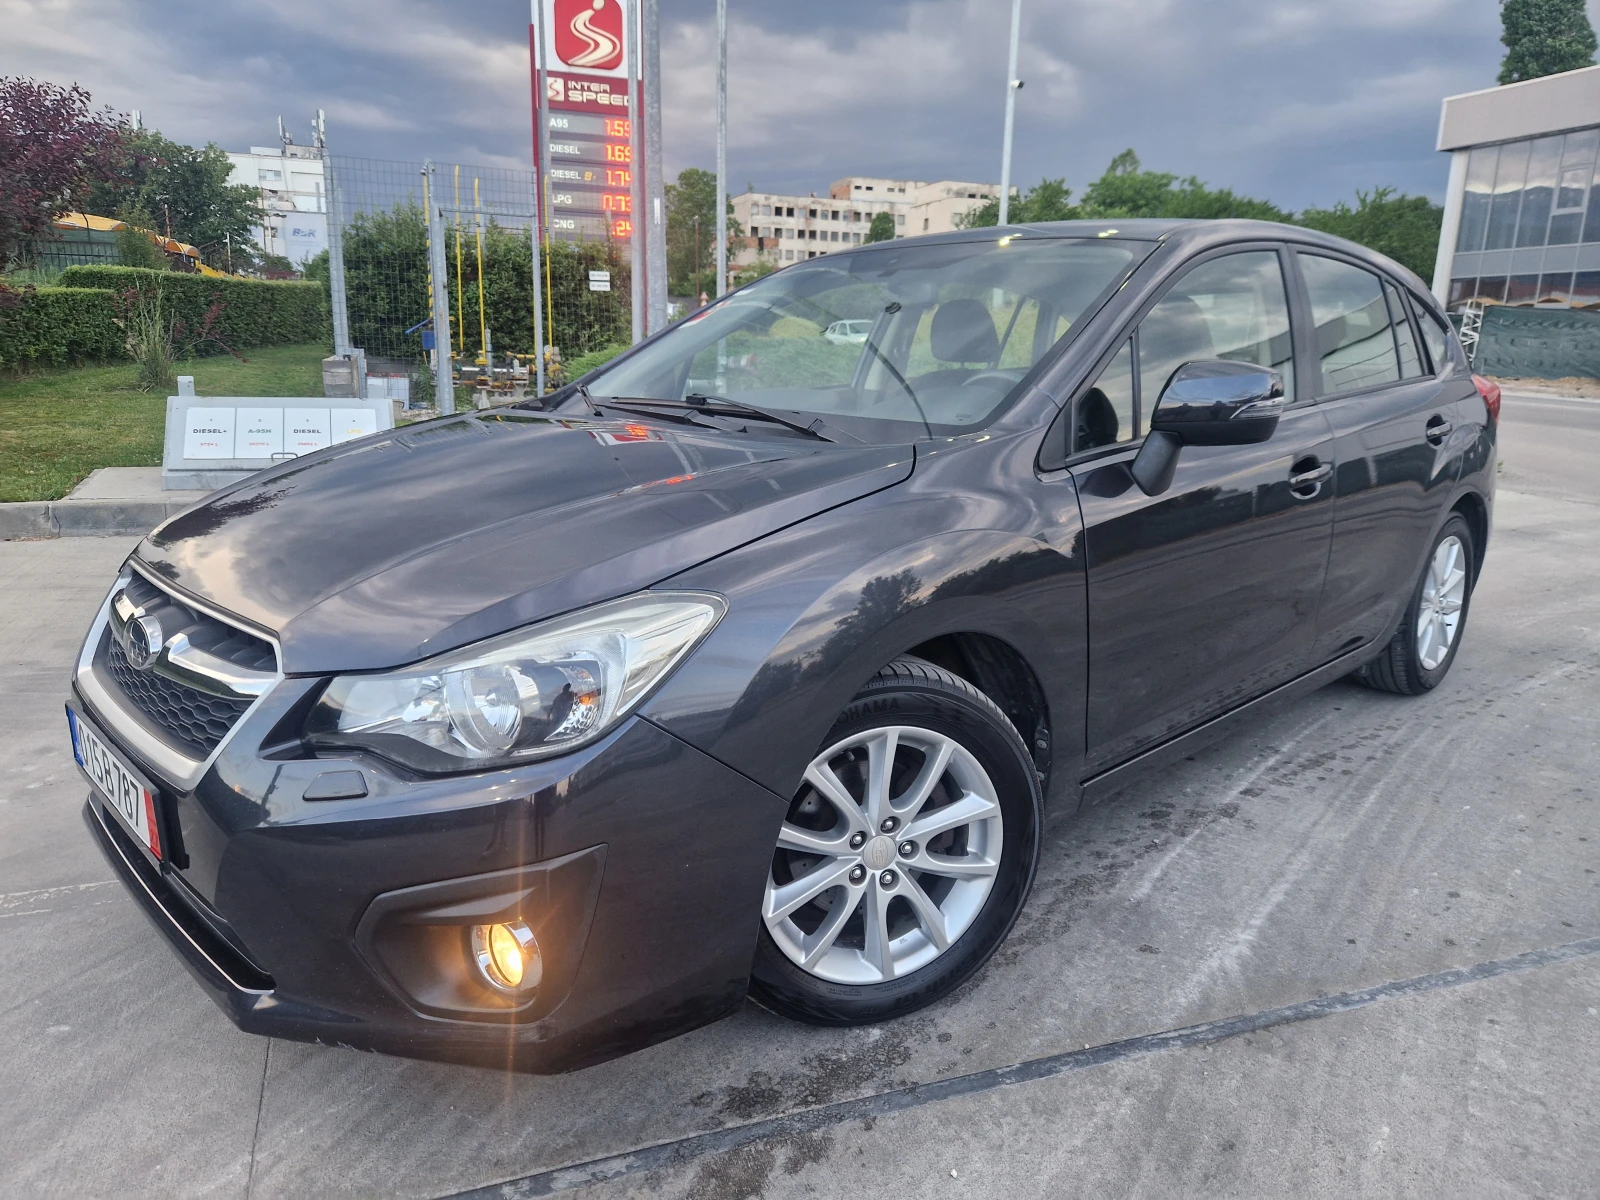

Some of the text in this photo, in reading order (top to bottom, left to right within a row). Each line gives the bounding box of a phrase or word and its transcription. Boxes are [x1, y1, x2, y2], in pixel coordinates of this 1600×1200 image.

[568, 80, 610, 93] INTER
[549, 118, 569, 129] A95
[550, 144, 581, 155] DIESEL
[551, 169, 582, 180] DIESEL
[552, 194, 573, 205] LPG
[553, 219, 575, 230] CNG
